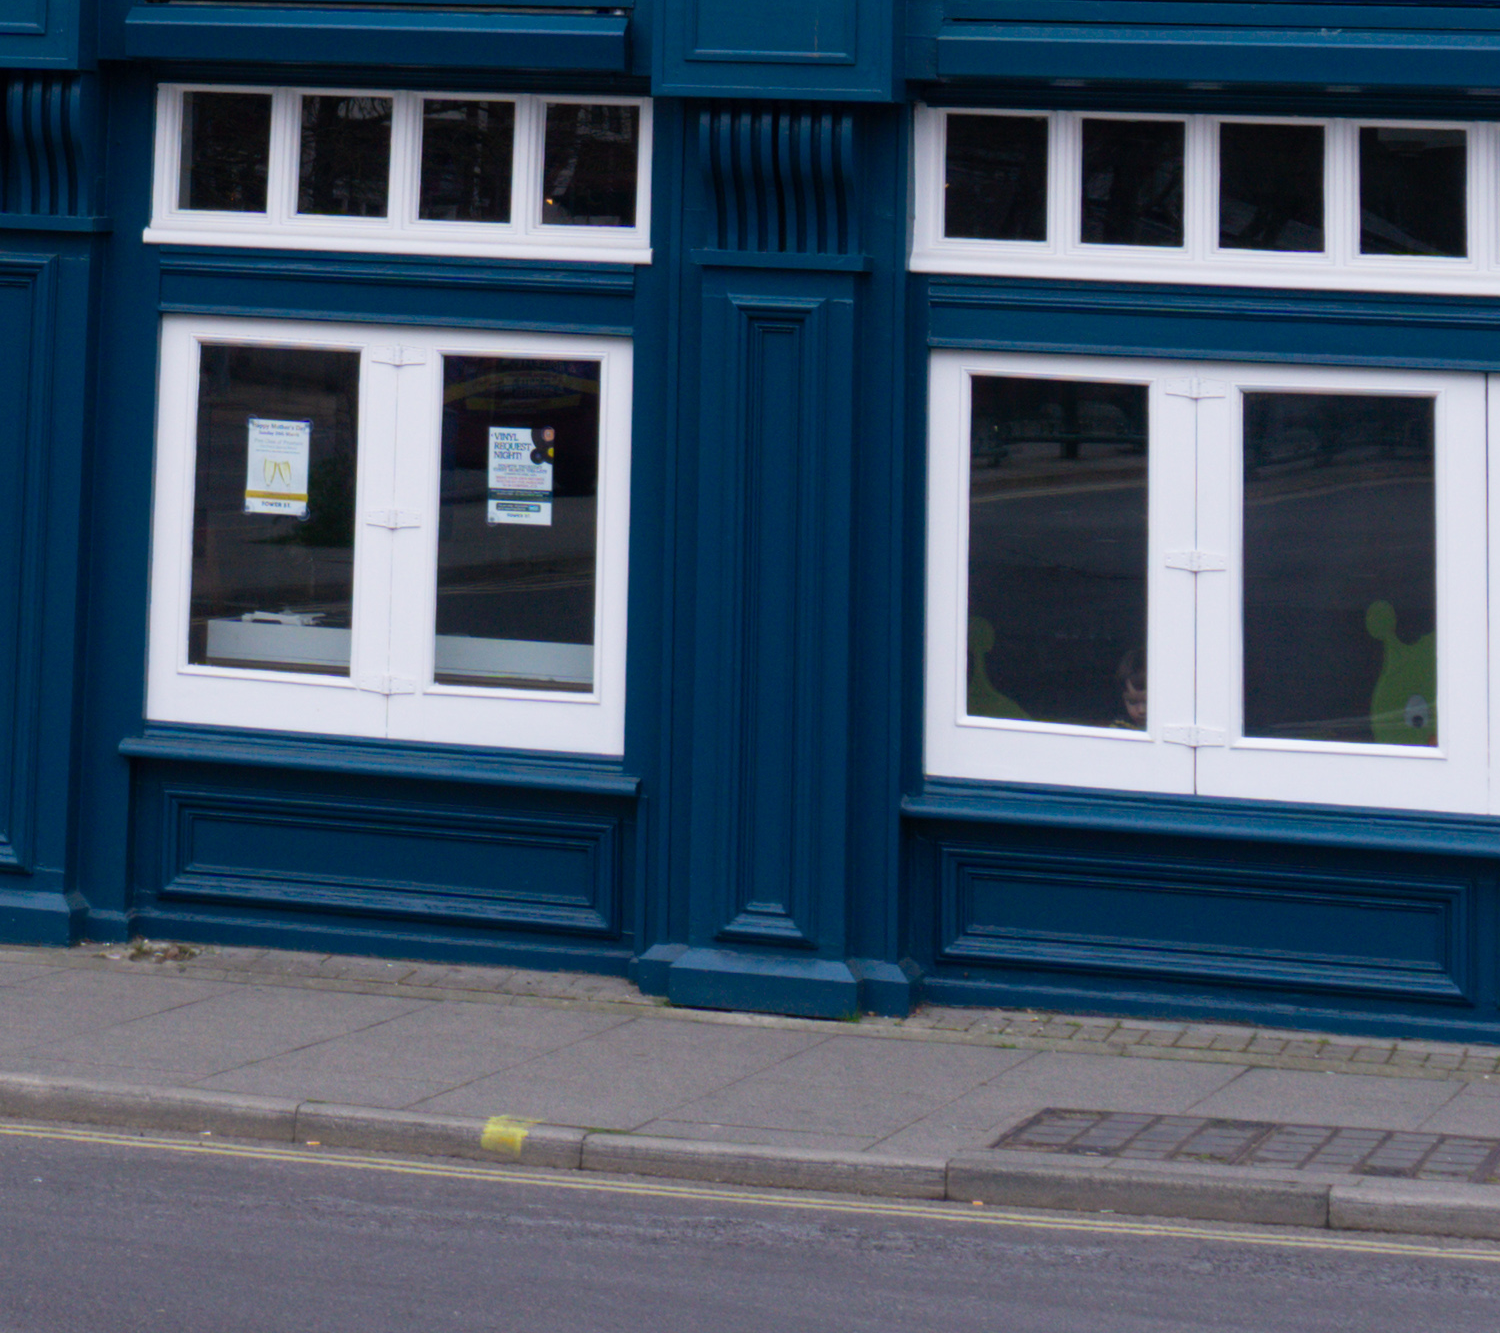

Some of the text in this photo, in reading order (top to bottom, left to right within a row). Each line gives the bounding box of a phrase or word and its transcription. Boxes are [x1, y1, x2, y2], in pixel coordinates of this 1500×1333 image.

[494, 432, 519, 441] VINYL
[494, 442, 532, 451] REQUEST
[494, 451, 522, 460] NIGHT!
